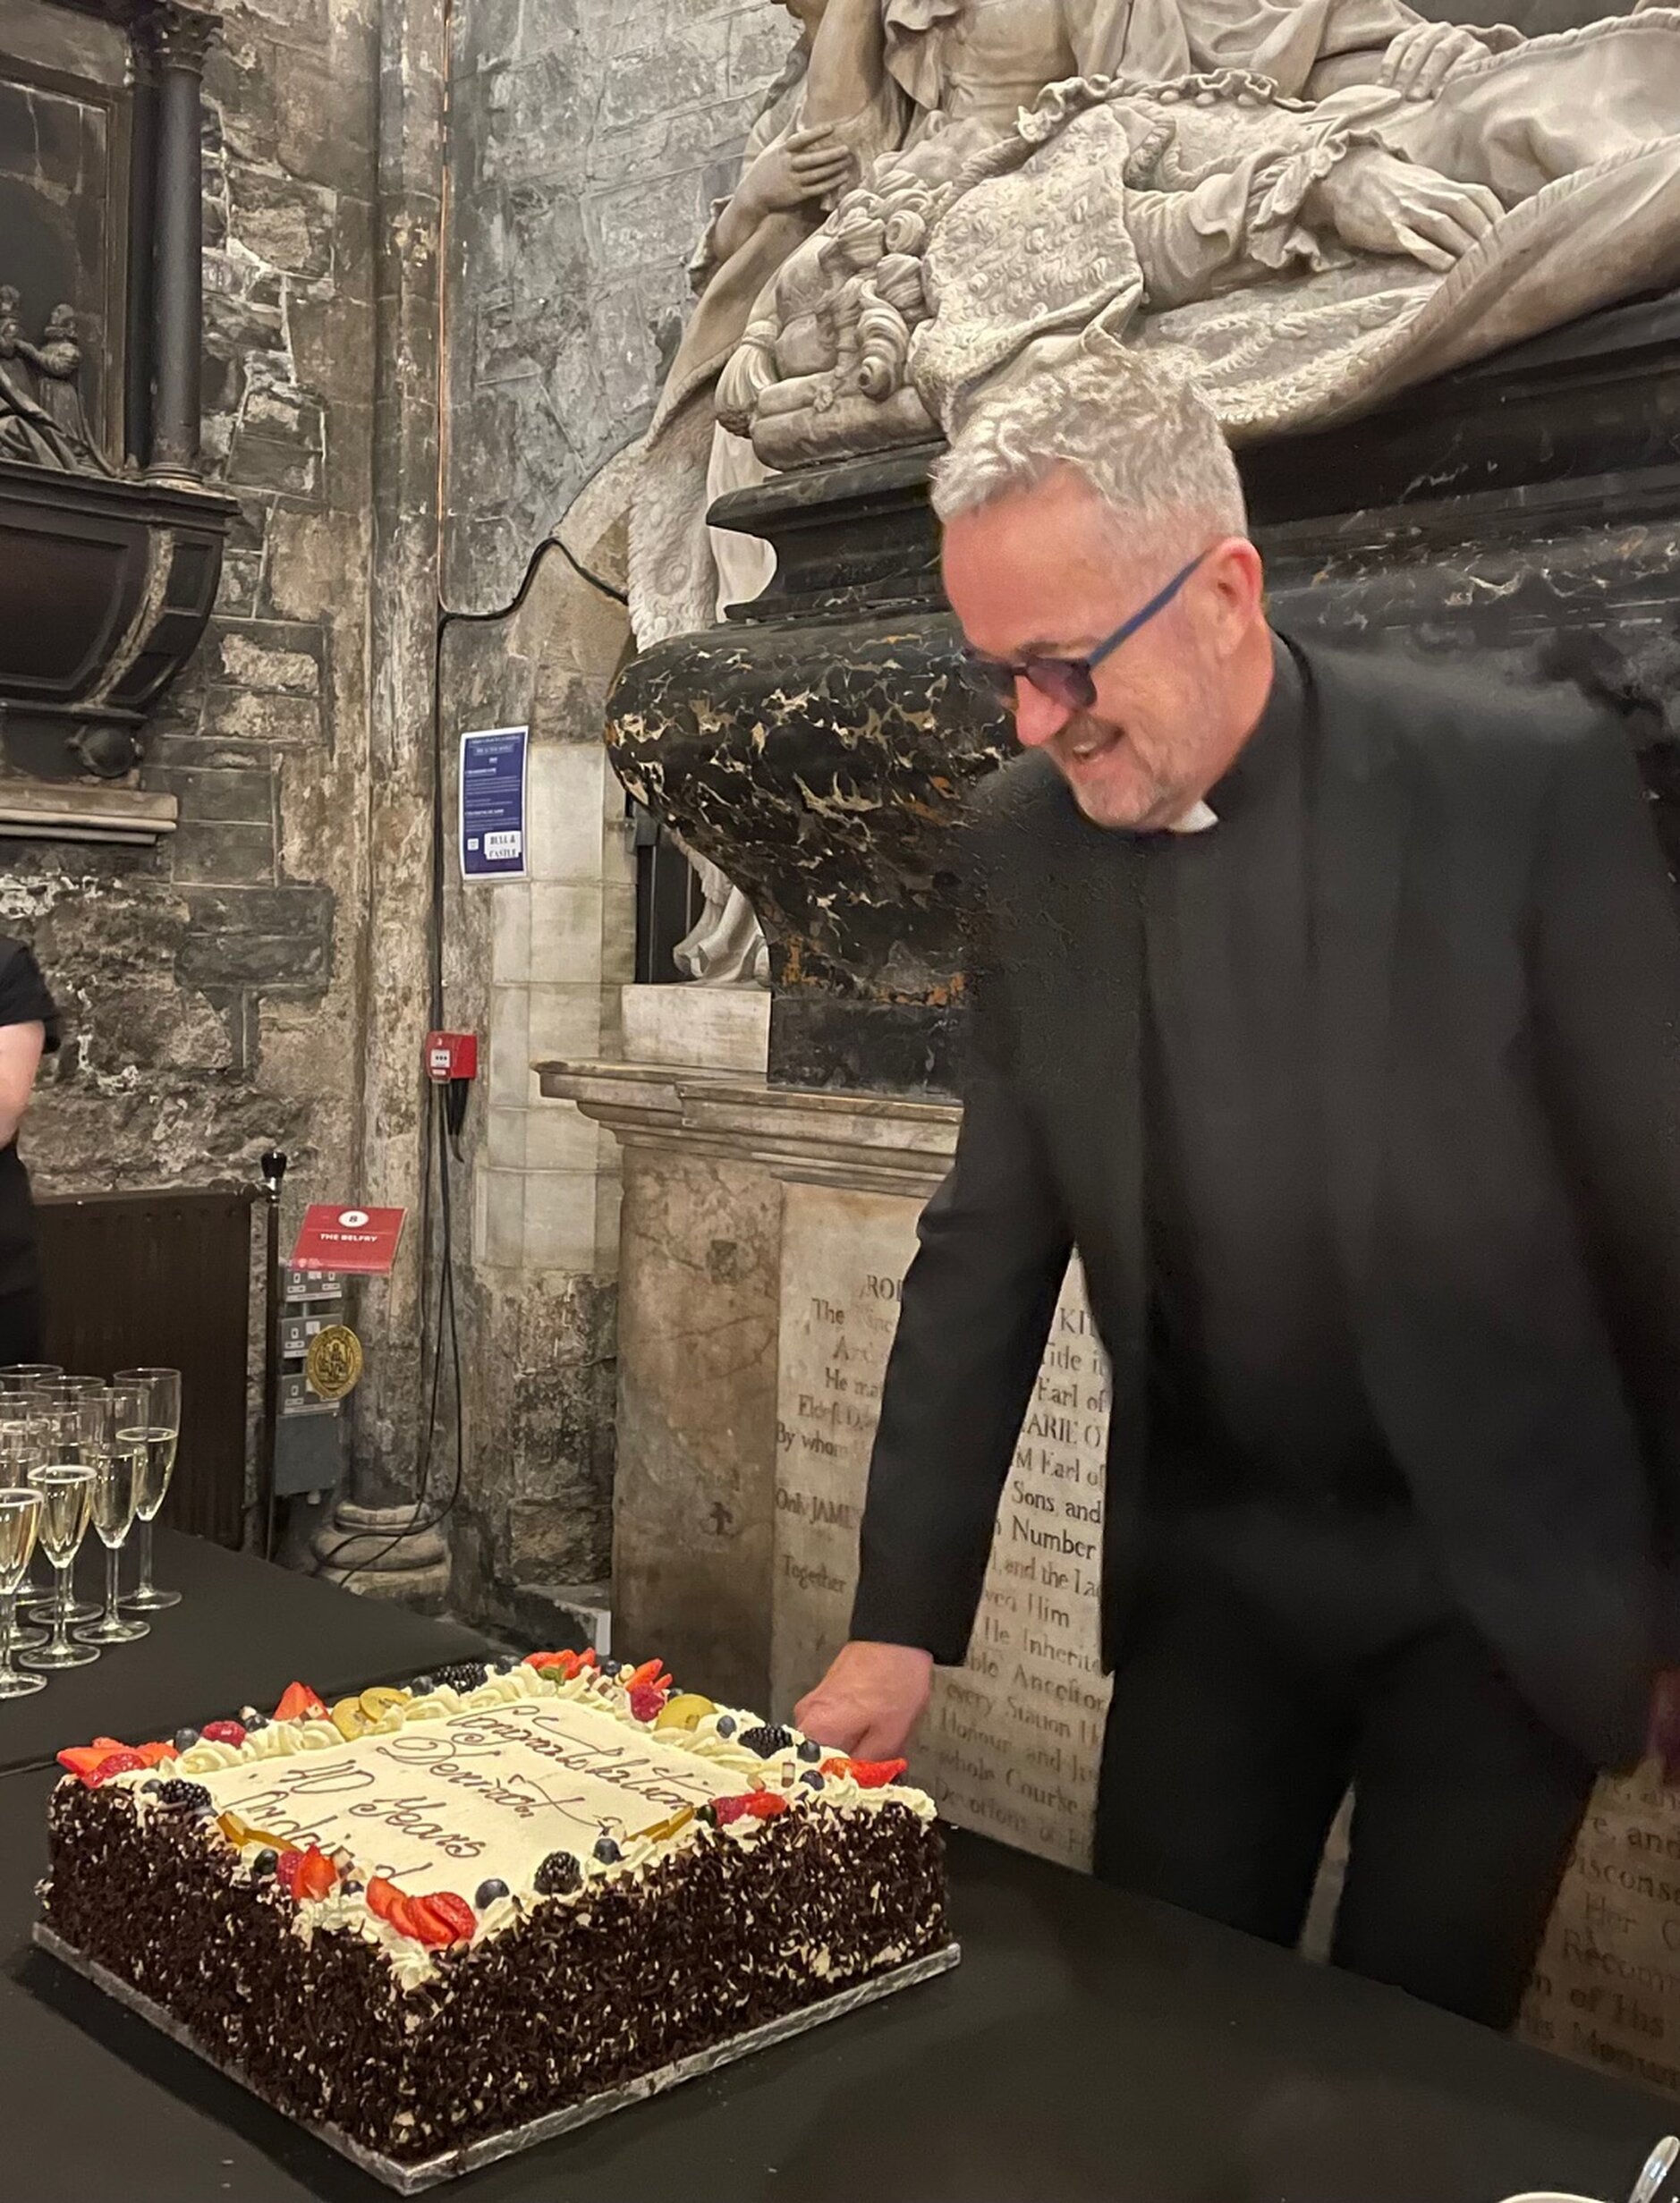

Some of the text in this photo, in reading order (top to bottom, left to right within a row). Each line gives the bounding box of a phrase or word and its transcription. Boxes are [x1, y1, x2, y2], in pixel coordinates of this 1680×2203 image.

[319, 1233, 378, 1243] THE BELFRY
[811, 1298, 844, 1326] The
[824, 1368, 848, 1392] He
[1038, 1376, 1078, 1409] Earl
[776, 1421, 795, 1453] By
[1012, 1480, 1101, 1524] Sons and
[1012, 1515, 1097, 1560] Number
[780, 1555, 845, 1595] Together
[1041, 1561, 1069, 1591] the
[279, 1758, 484, 1859] 40 Years
